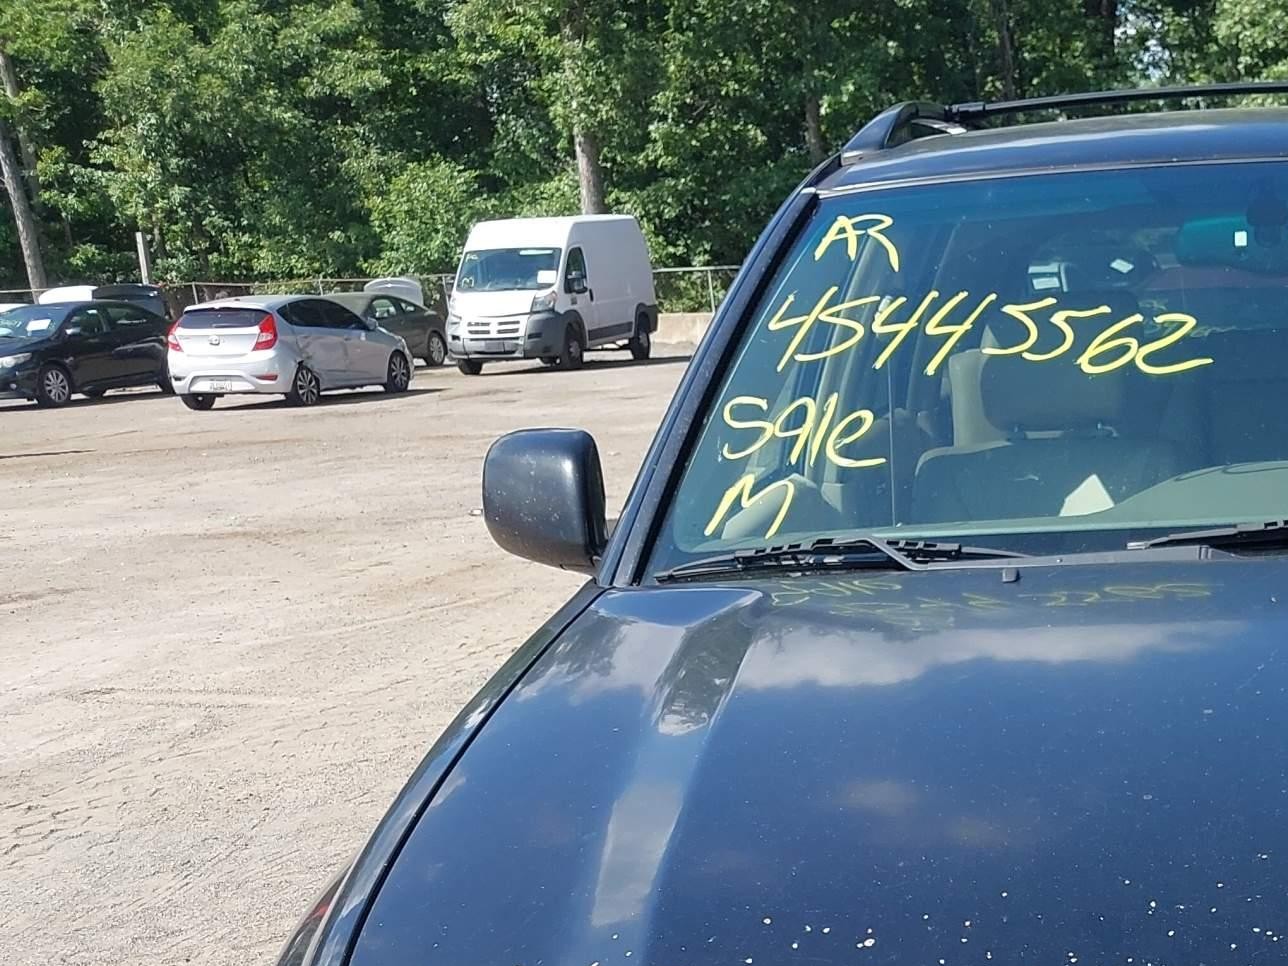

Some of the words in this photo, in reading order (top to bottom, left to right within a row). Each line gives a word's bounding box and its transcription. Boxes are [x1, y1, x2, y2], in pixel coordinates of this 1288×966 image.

[767, 285, 1216, 376] 45445562
[721, 392, 887, 468] Sale
[703, 473, 795, 540] M
